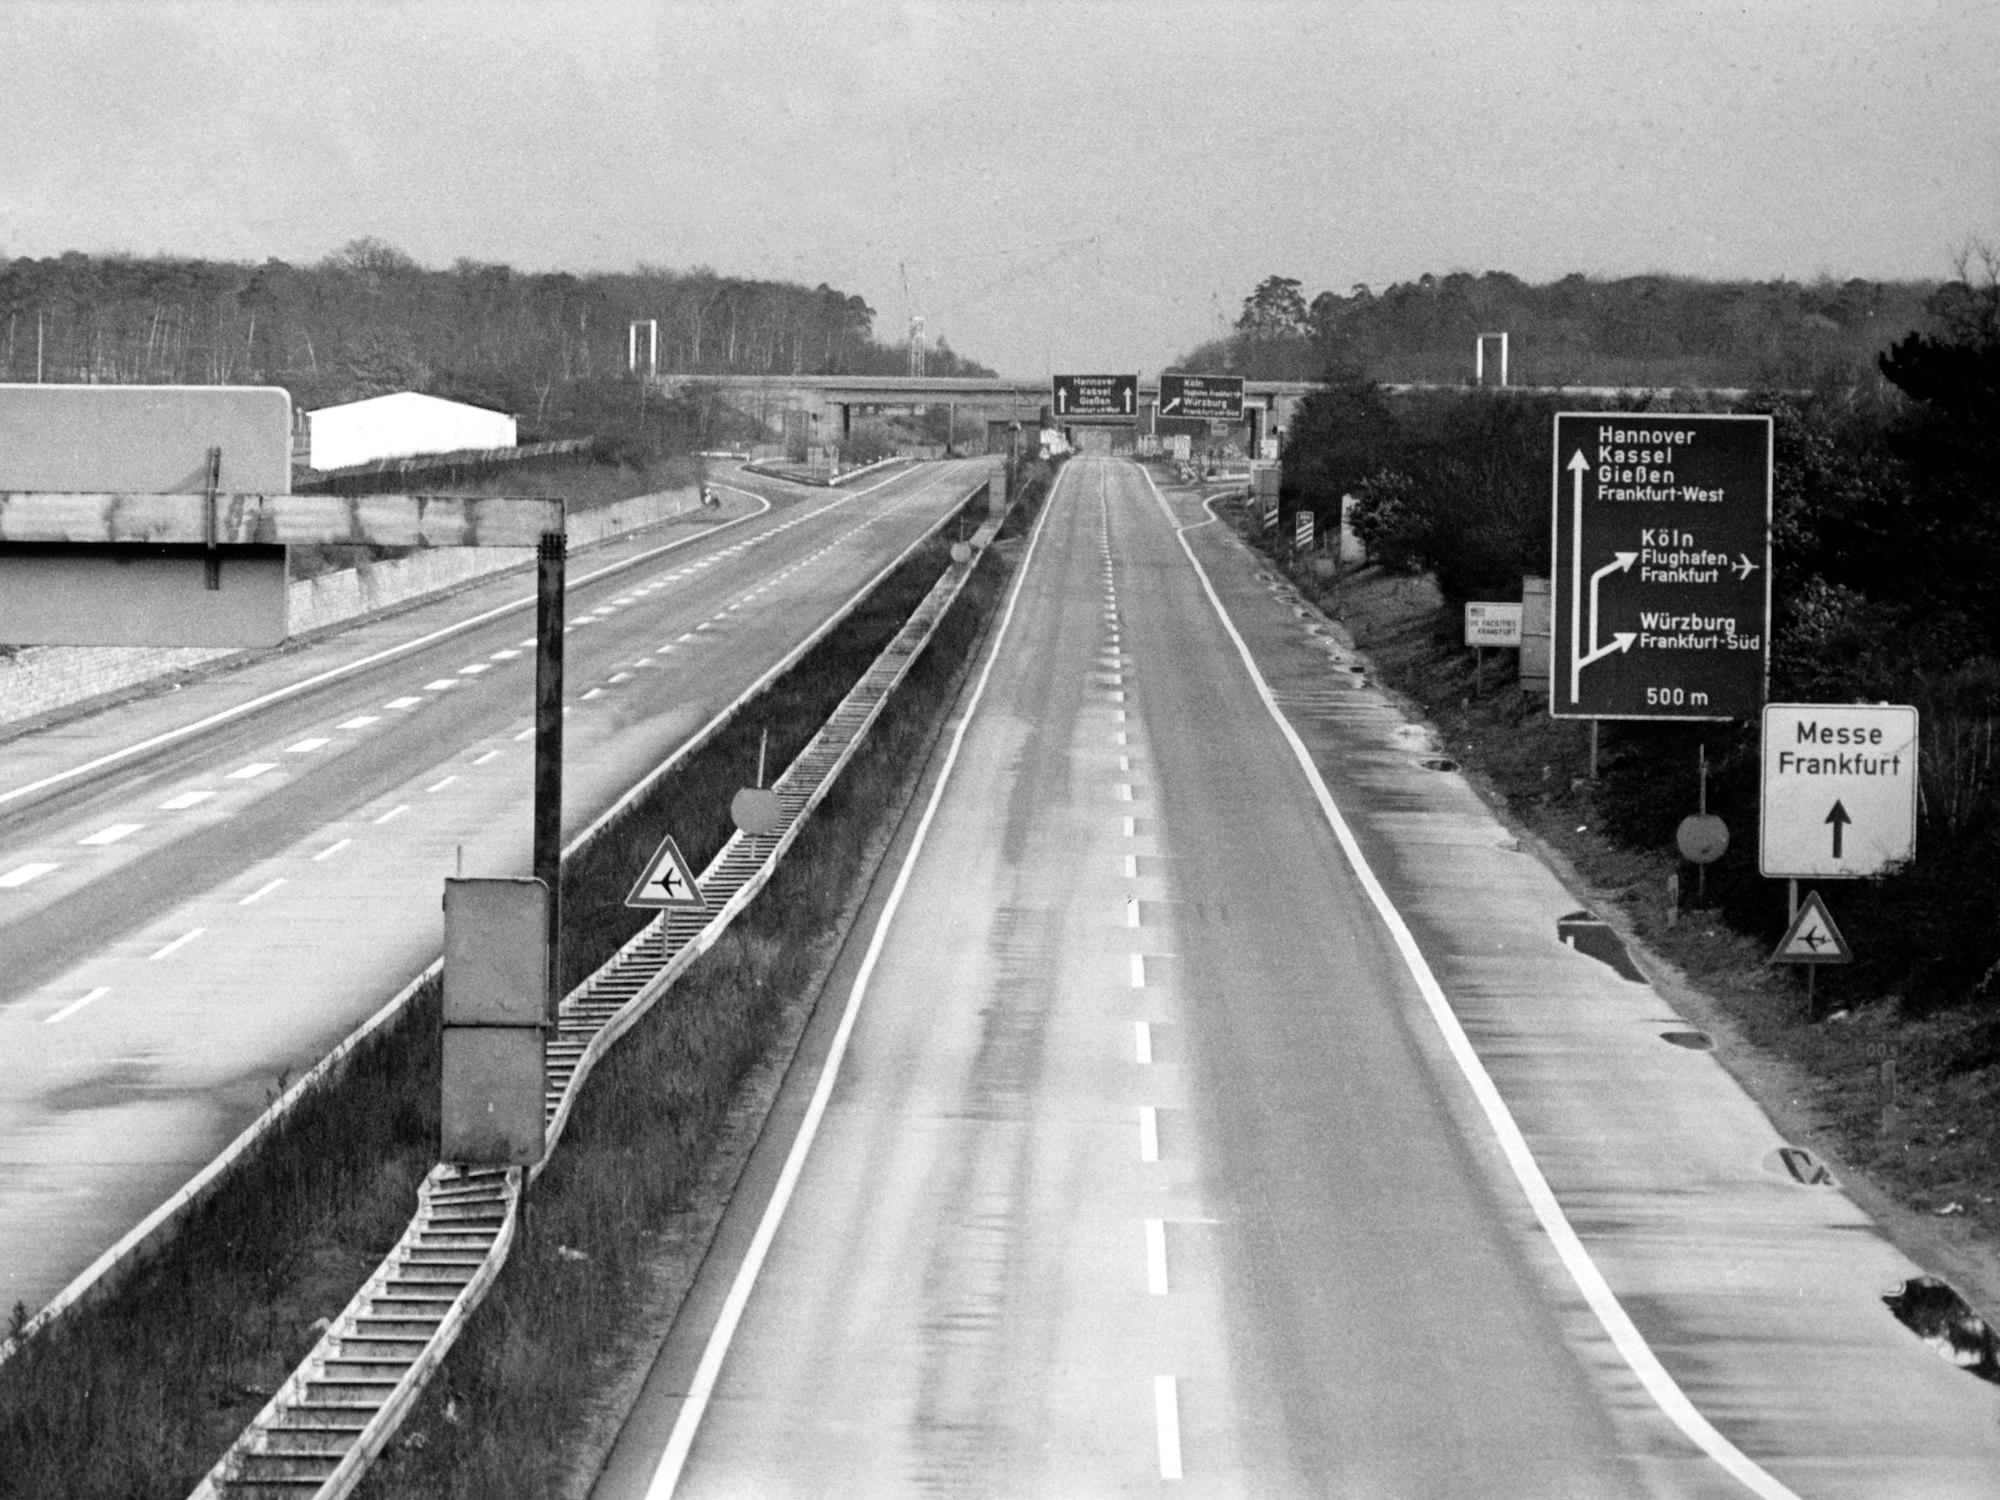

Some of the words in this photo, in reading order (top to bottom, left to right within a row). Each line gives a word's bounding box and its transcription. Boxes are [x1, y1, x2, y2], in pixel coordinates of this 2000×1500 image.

[1073, 377, 1116, 386] Hannover
[1079, 387, 1111, 396] Kassel
[1600, 425, 1696, 444] Hannover
[1600, 446, 1672, 464] Kassel
[1599, 465, 1675, 484] Gießen
[1598, 485, 1725, 502] Frankfurt-West
[1641, 529, 1694, 547] Köln
[1641, 549, 1728, 567] Flughafen
[1641, 567, 1719, 583] Frankfurt
[1482, 619, 1516, 627] FACILITIES
[1640, 612, 1736, 636] Würzburg
[1640, 632, 1760, 650] Frankfurt-Süd
[1647, 688, 1684, 706] 500
[1690, 692, 1708, 706] m
[1797, 721, 1882, 745] Messe
[1779, 752, 1901, 776] Frankfurt
